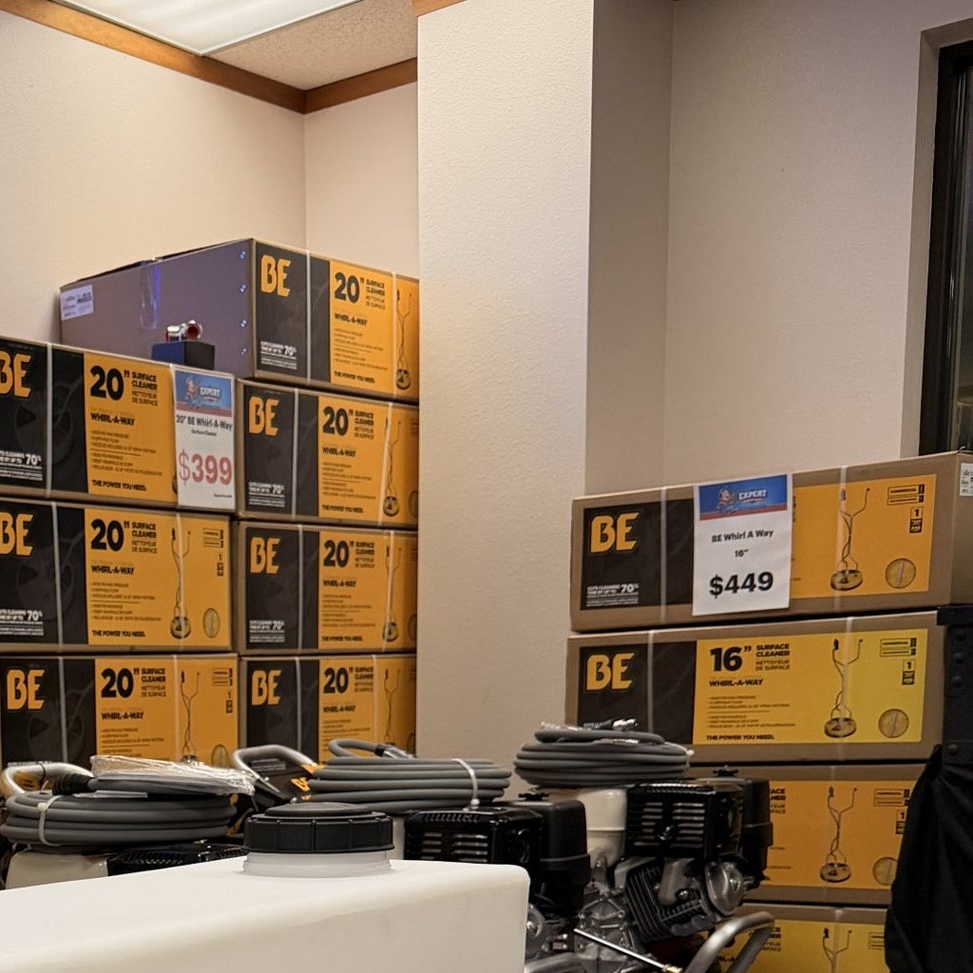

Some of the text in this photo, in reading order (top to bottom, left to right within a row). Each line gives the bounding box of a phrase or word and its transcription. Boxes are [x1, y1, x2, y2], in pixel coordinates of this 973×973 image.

[260, 254, 290, 298] BE
[91, 412, 135, 426] WHIRL-A-WAY
[187, 416, 195, 425] BE
[197, 417, 232, 432] Whirl-A-Way
[249, 396, 279, 436] BE
[178, 449, 232, 486] $399
[590, 512, 639, 554] BE
[711, 534, 722, 543] BE
[724, 531, 745, 541] Whirl
[755, 529, 774, 537] Way
[250, 537, 280, 574] BE
[621, 583, 639, 594] 70%
[709, 572, 774, 599] $449
[7, 670, 44, 709] BE
[252, 670, 281, 705] BE
[586, 653, 635, 690] BE
